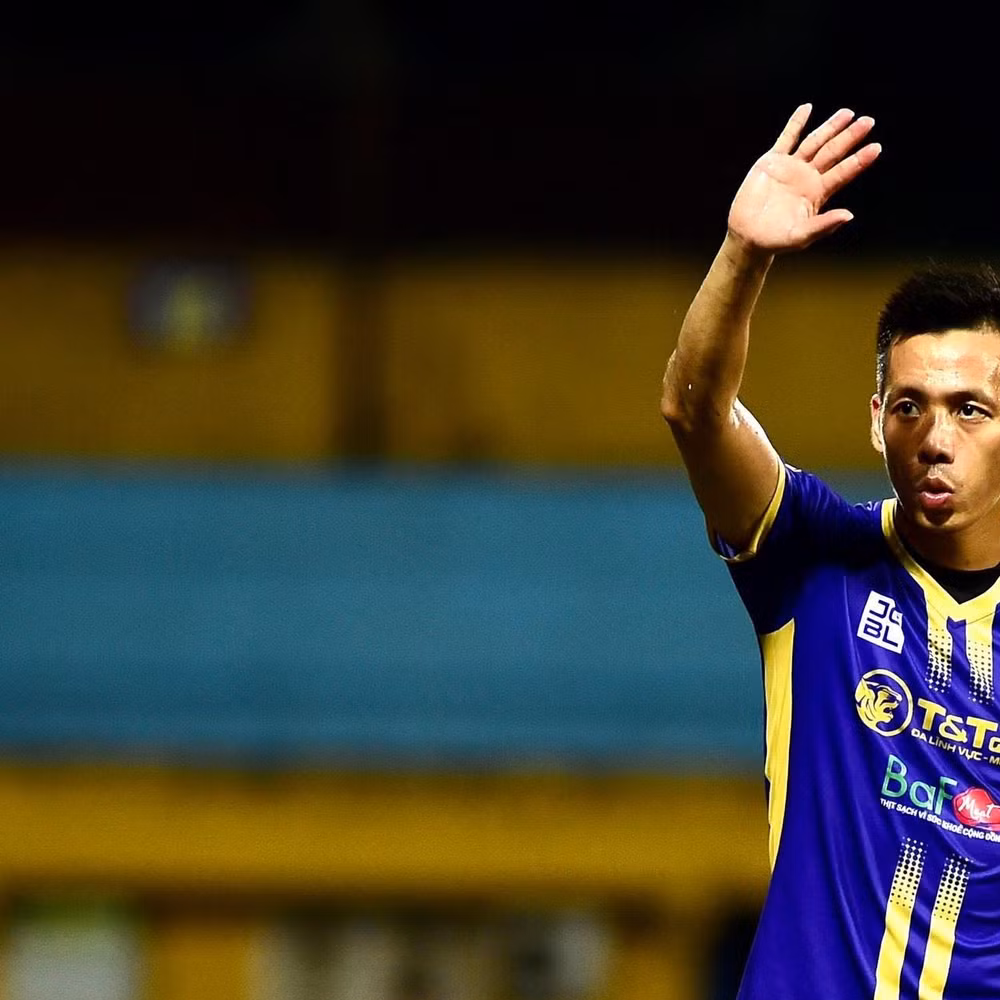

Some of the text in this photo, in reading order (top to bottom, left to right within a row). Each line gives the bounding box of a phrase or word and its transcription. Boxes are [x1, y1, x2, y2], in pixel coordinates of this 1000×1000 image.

[863, 617, 899, 648] BL
[917, 698, 998, 749] T&T
[880, 798, 896, 810] THỊT
[896, 803, 918, 817] SẠCH
[918, 810, 927, 820] VÌ
[962, 828, 985, 840] CỘNG
